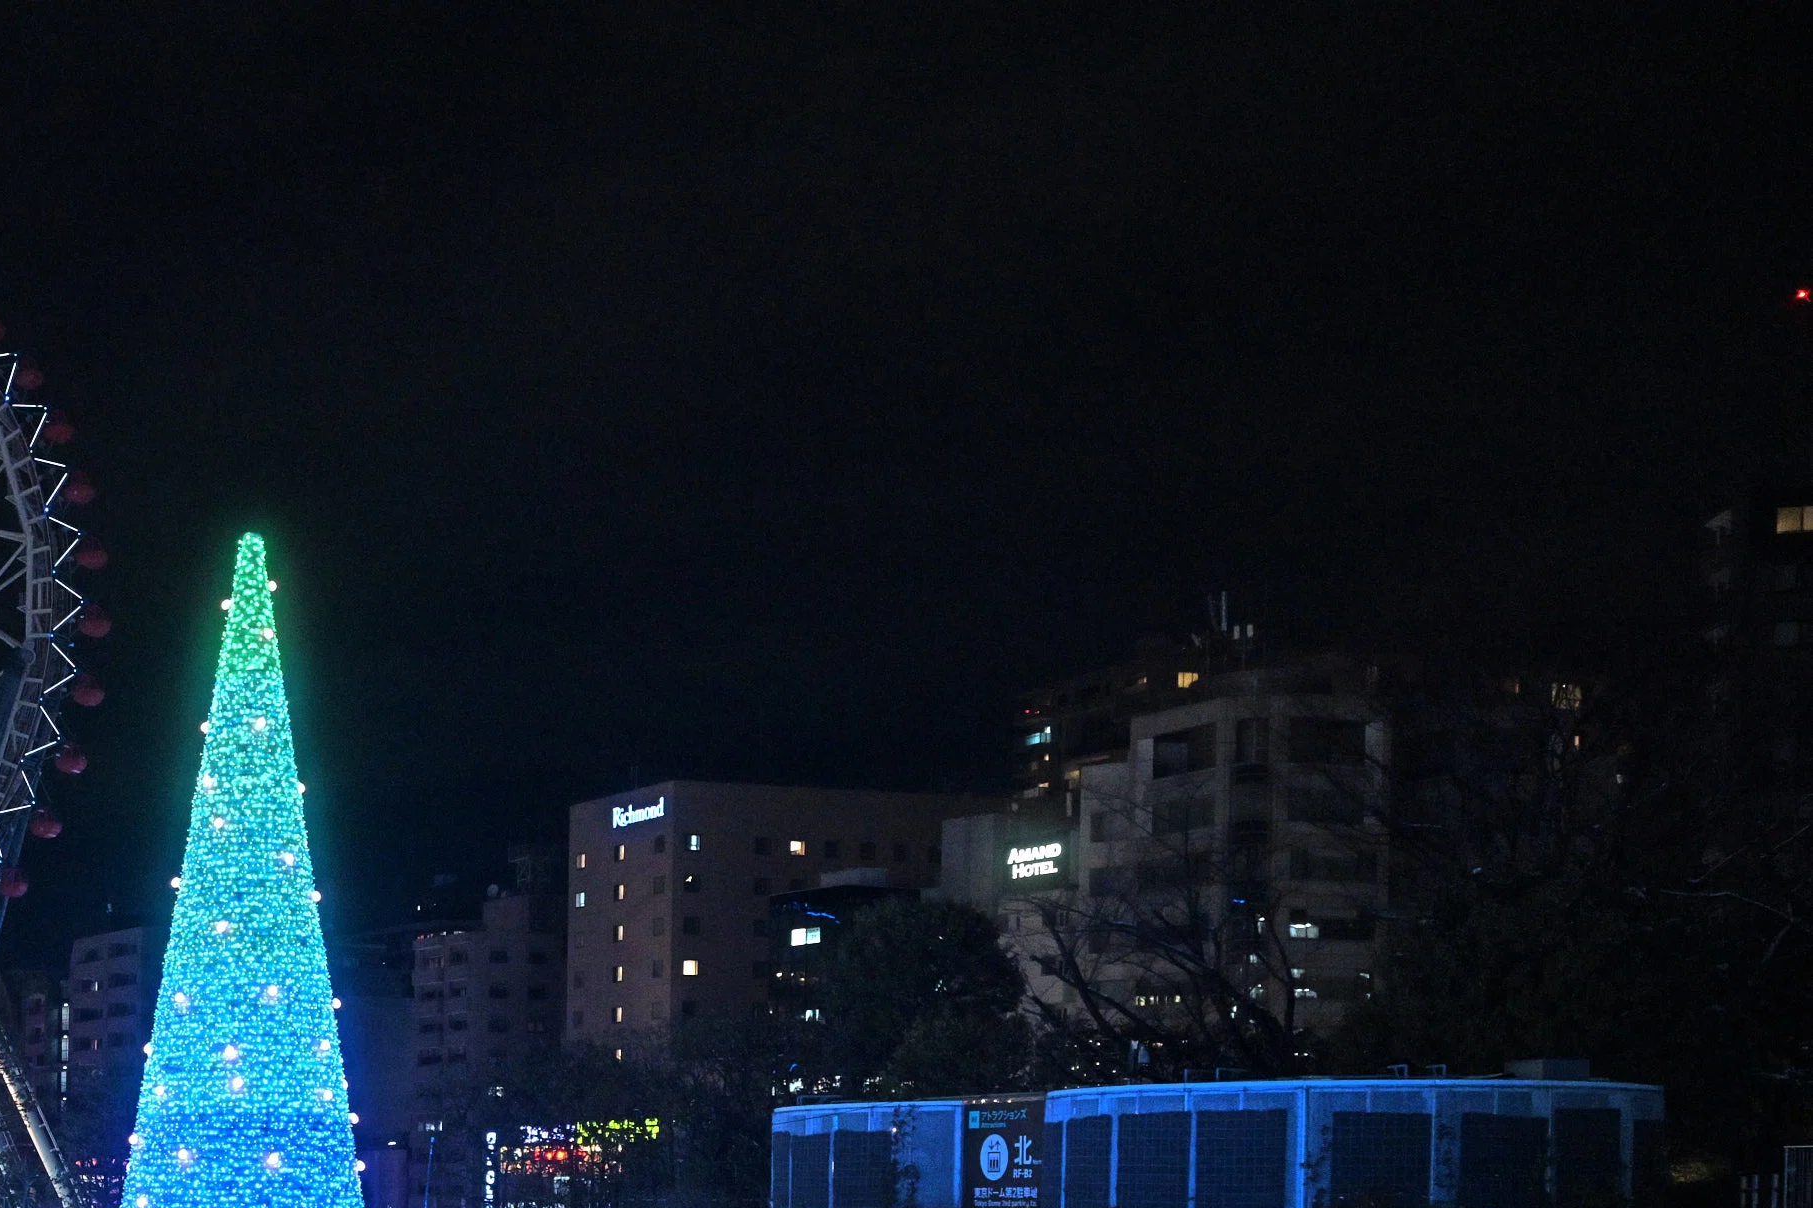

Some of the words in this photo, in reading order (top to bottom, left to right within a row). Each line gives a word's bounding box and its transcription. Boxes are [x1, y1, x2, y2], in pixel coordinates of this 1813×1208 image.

[612, 796, 665, 828] Richmond
[1011, 860, 1059, 880] HOTEL
[1014, 1135, 1033, 1166] 北
[1013, 1169, 1032, 1178] RF-B2
